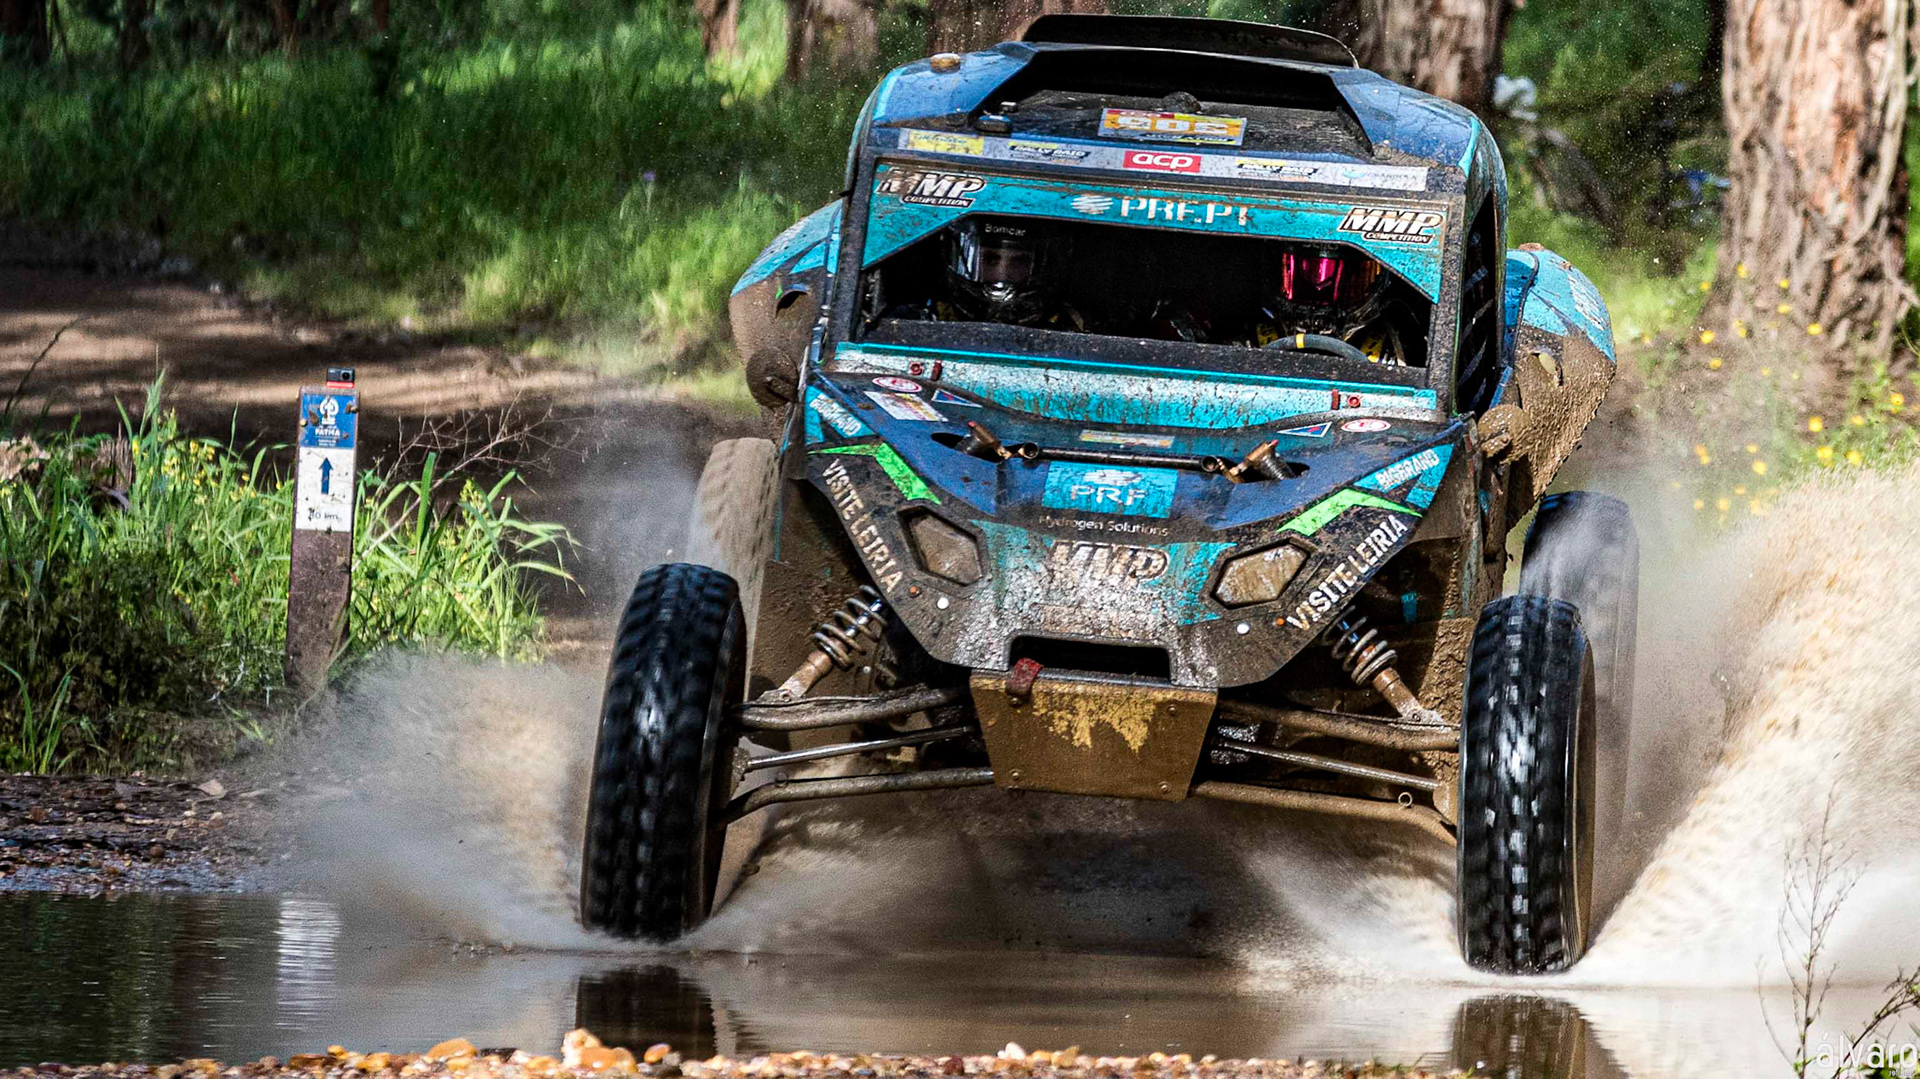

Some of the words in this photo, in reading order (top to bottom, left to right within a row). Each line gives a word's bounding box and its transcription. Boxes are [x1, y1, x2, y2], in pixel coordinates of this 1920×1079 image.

[1132, 153, 1194, 168] acp
[903, 196, 970, 206] COMPETITION
[1340, 207, 1442, 234] MMP
[1366, 231, 1430, 243] COMPETITION
[1070, 484, 1148, 506] PRF
[822, 458, 865, 521] VISITE
[850, 512, 903, 594] LEIRIA
[1039, 515, 1104, 531] Hydrogen
[1107, 520, 1169, 537] Solutions
[1286, 562, 1358, 631] VISITE
[1347, 514, 1409, 574] LEIRIA
